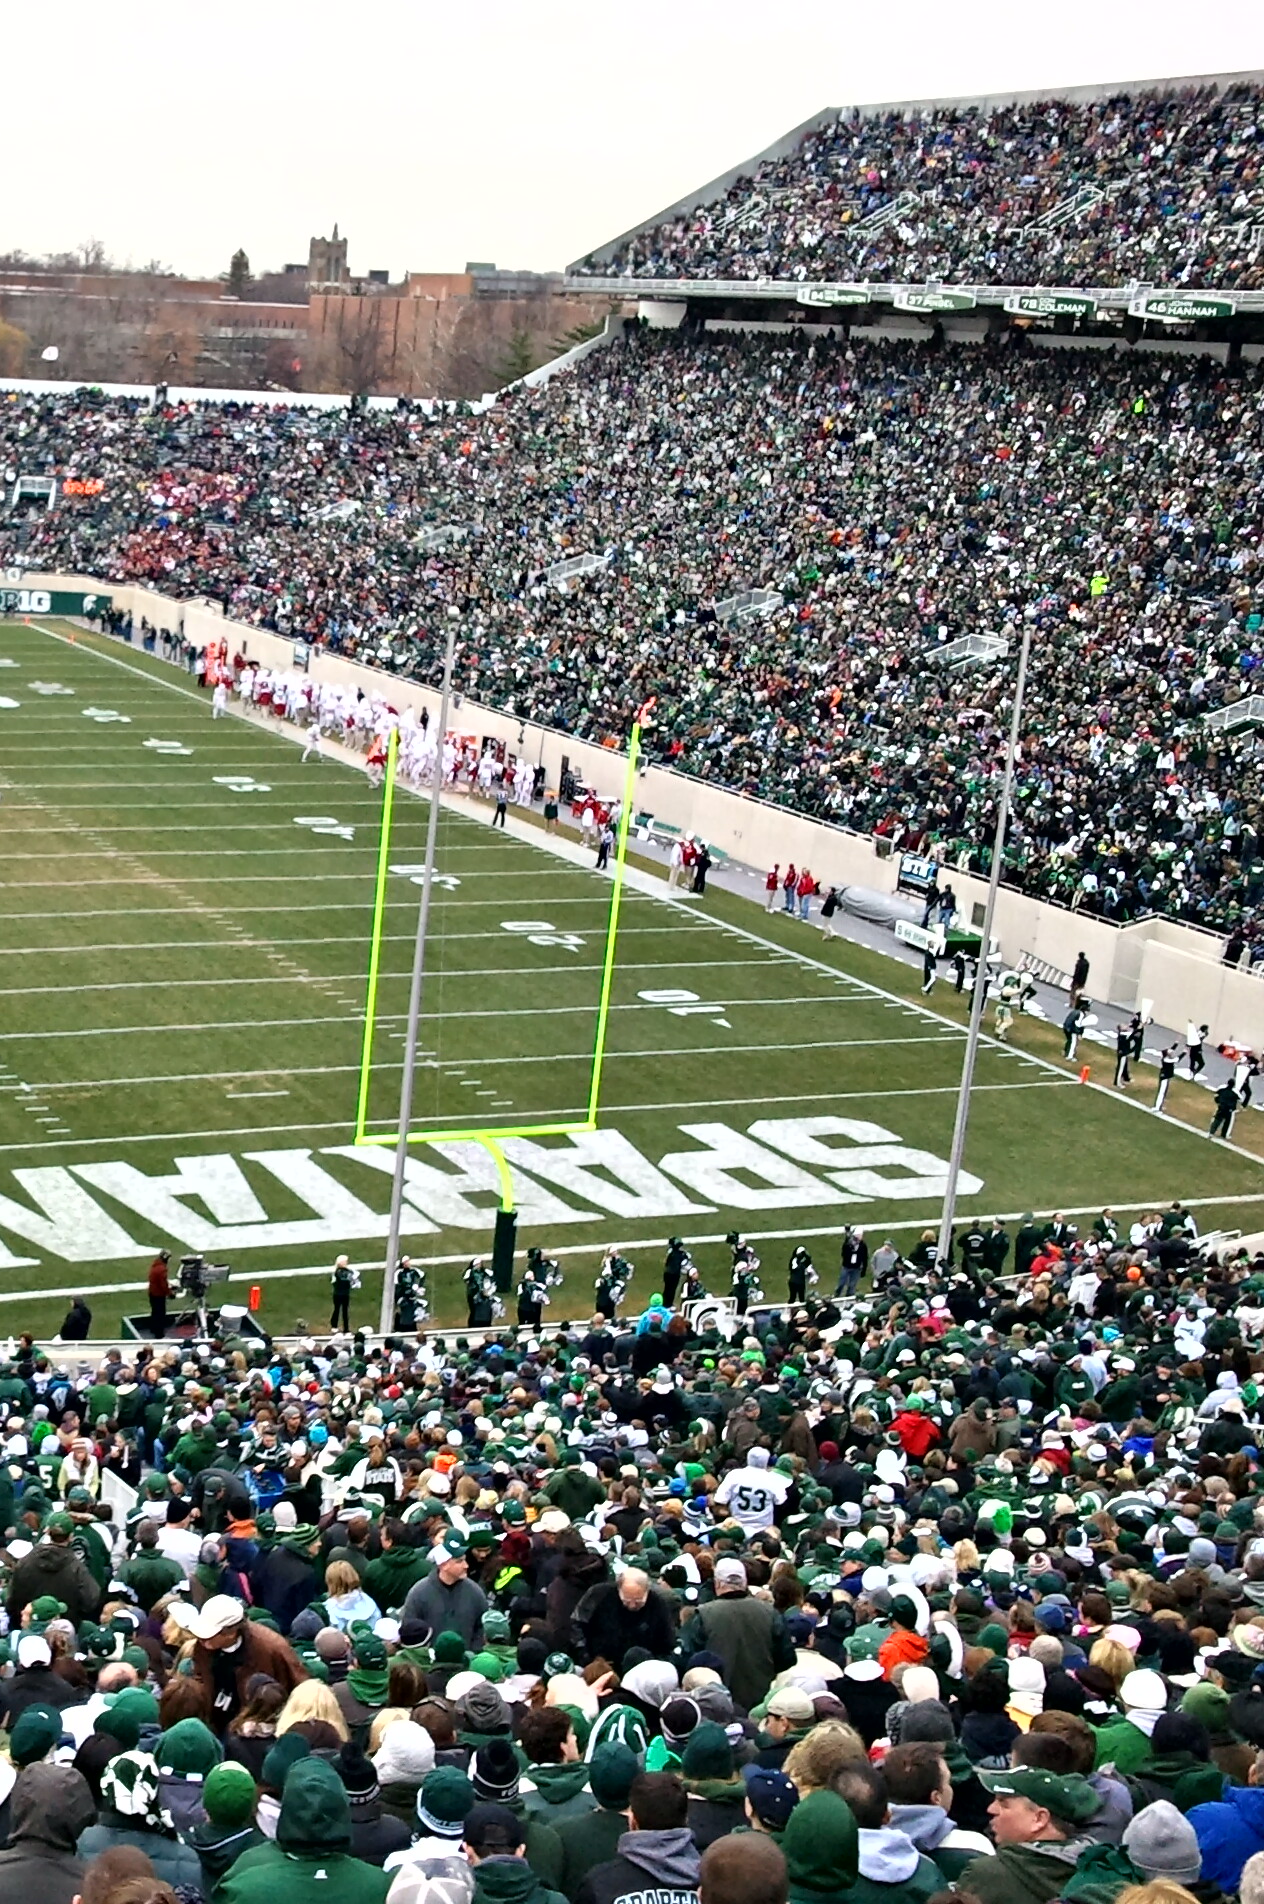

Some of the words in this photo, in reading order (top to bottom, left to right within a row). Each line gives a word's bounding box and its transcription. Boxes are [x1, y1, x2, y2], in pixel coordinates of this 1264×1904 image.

[1021, 298, 1037, 309] 78
[1038, 303, 1086, 313] COLEMAN
[1147, 301, 1167, 313] 46
[1167, 306, 1218, 317] HANNAH
[499, 921, 587, 947] 20
[637, 989, 727, 1017] 10
[38, 1464, 54, 1489] 5
[737, 1485, 767, 1512] 53
